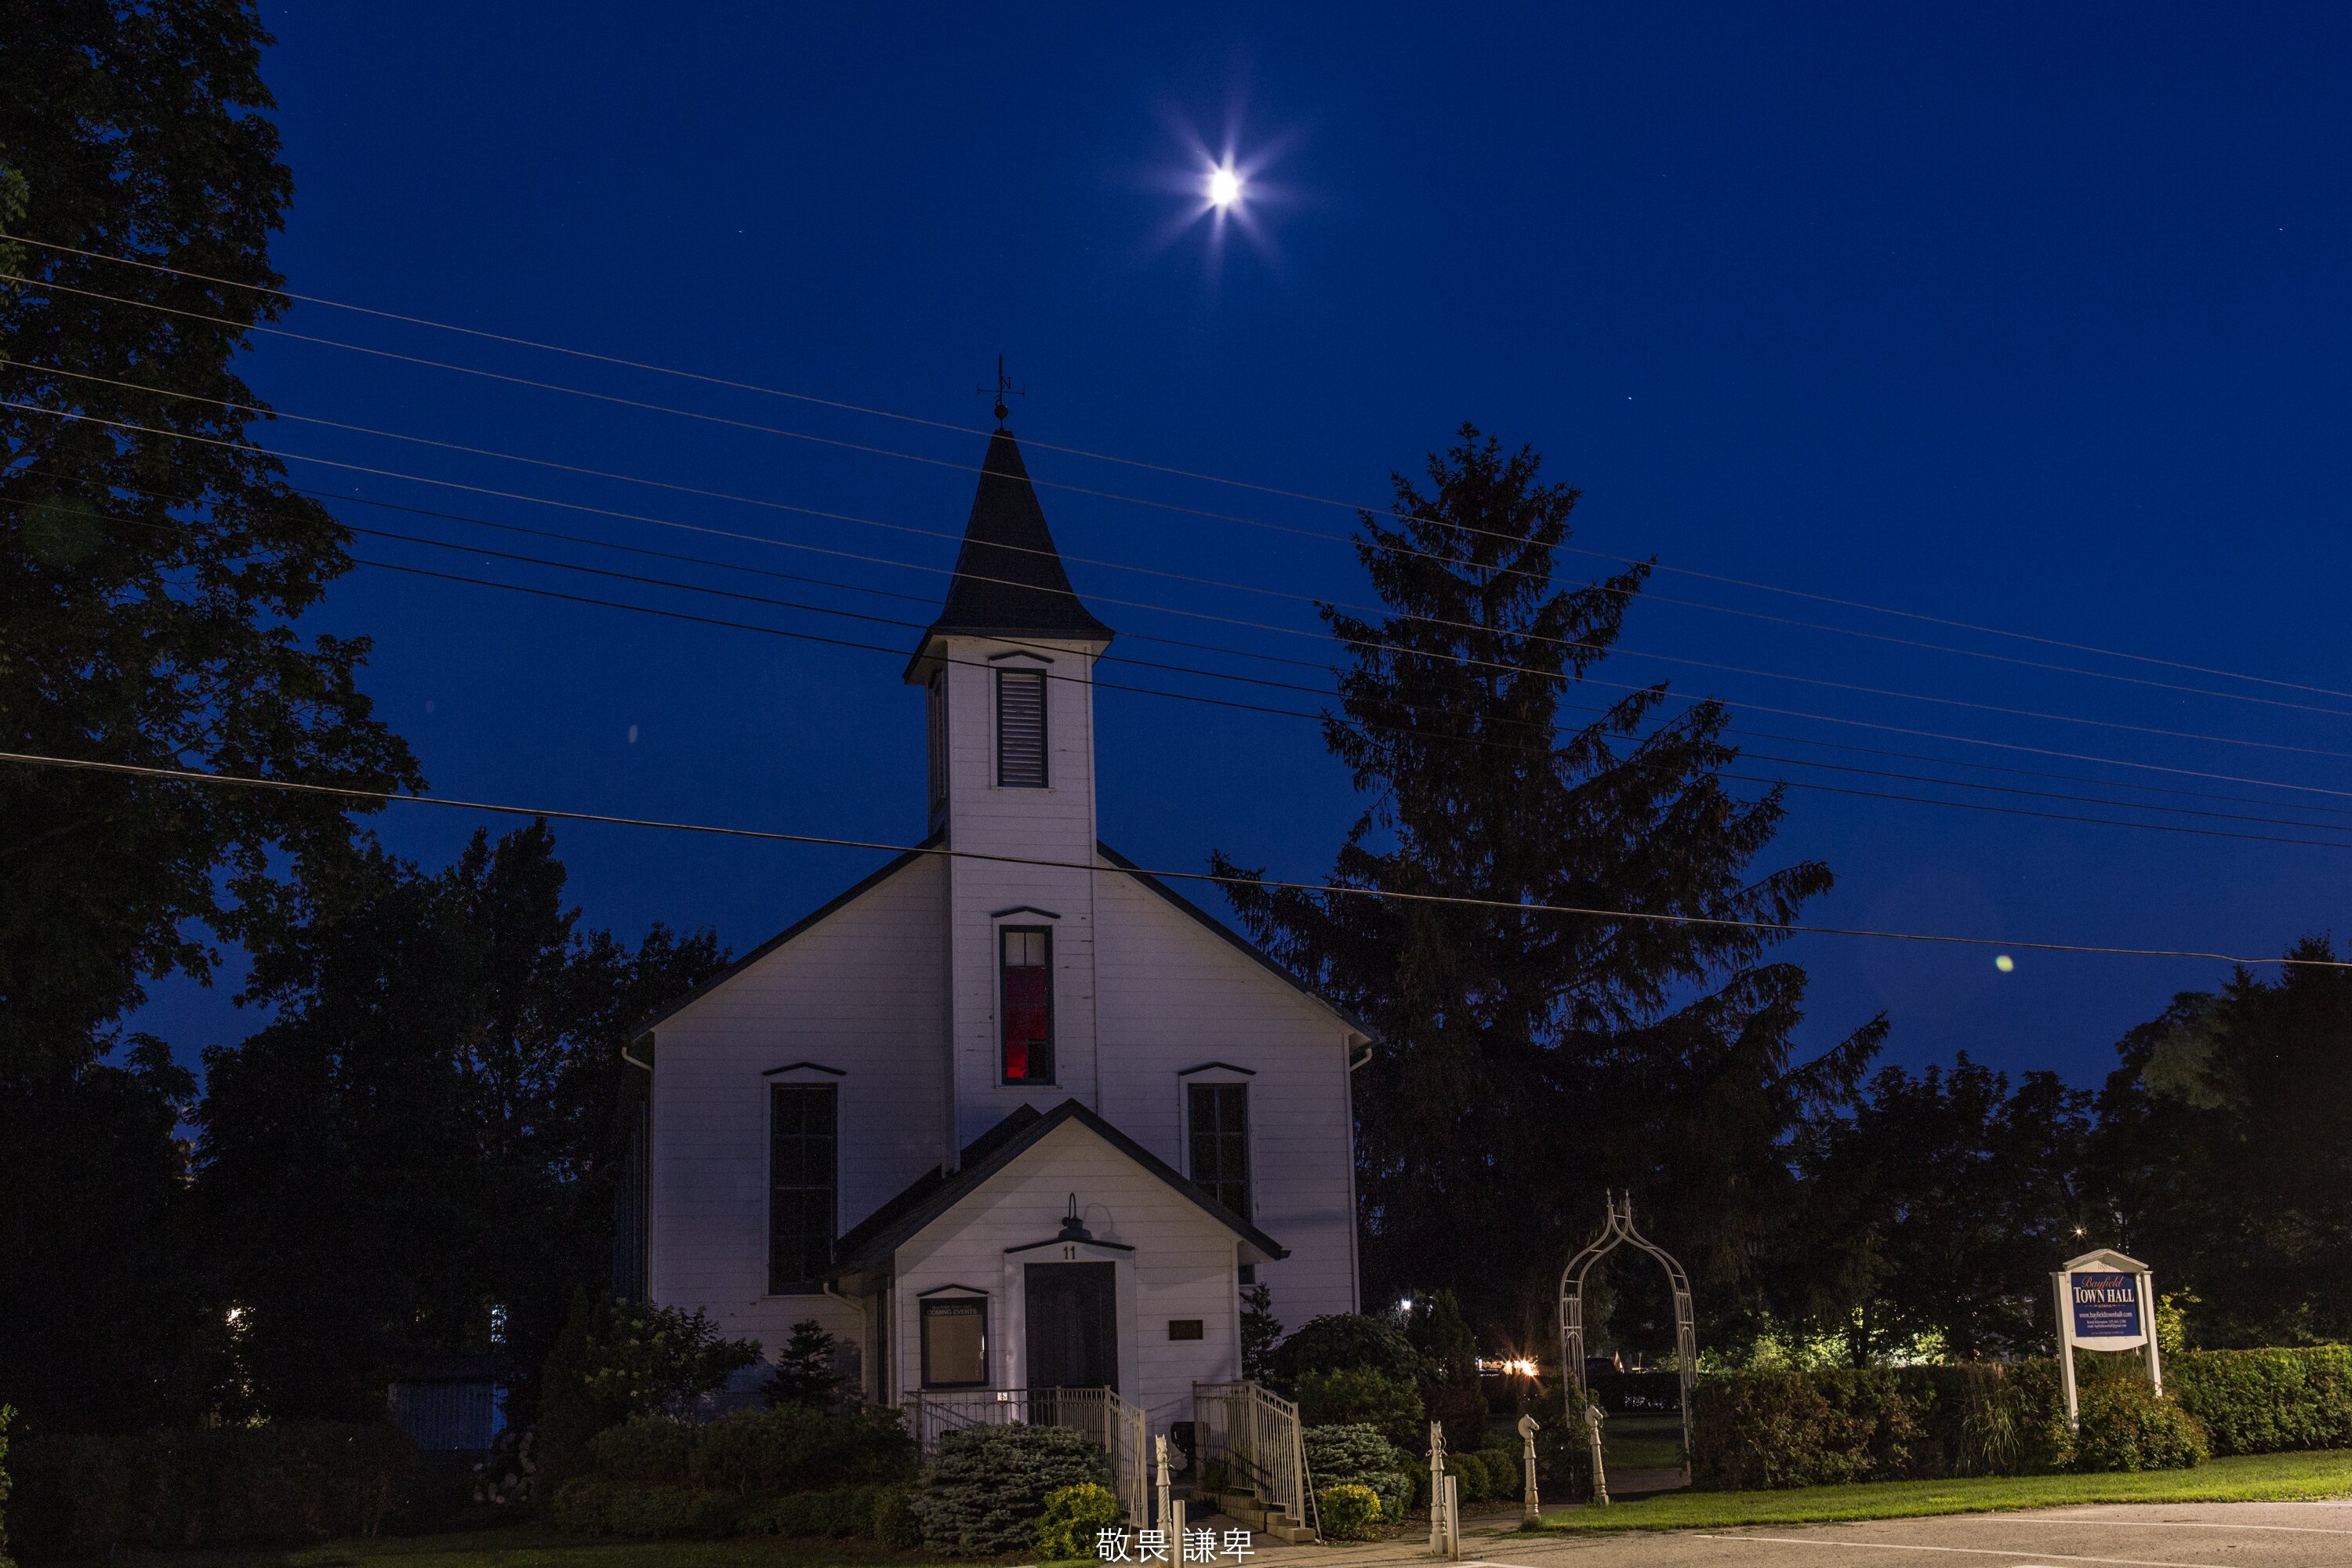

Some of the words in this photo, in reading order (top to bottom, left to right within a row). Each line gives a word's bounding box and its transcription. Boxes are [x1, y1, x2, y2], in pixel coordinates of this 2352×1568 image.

[1063, 1245, 1076, 1260] 11
[2082, 1276, 2123, 1289] Bayfield
[2107, 1289, 2134, 1302] HALL
